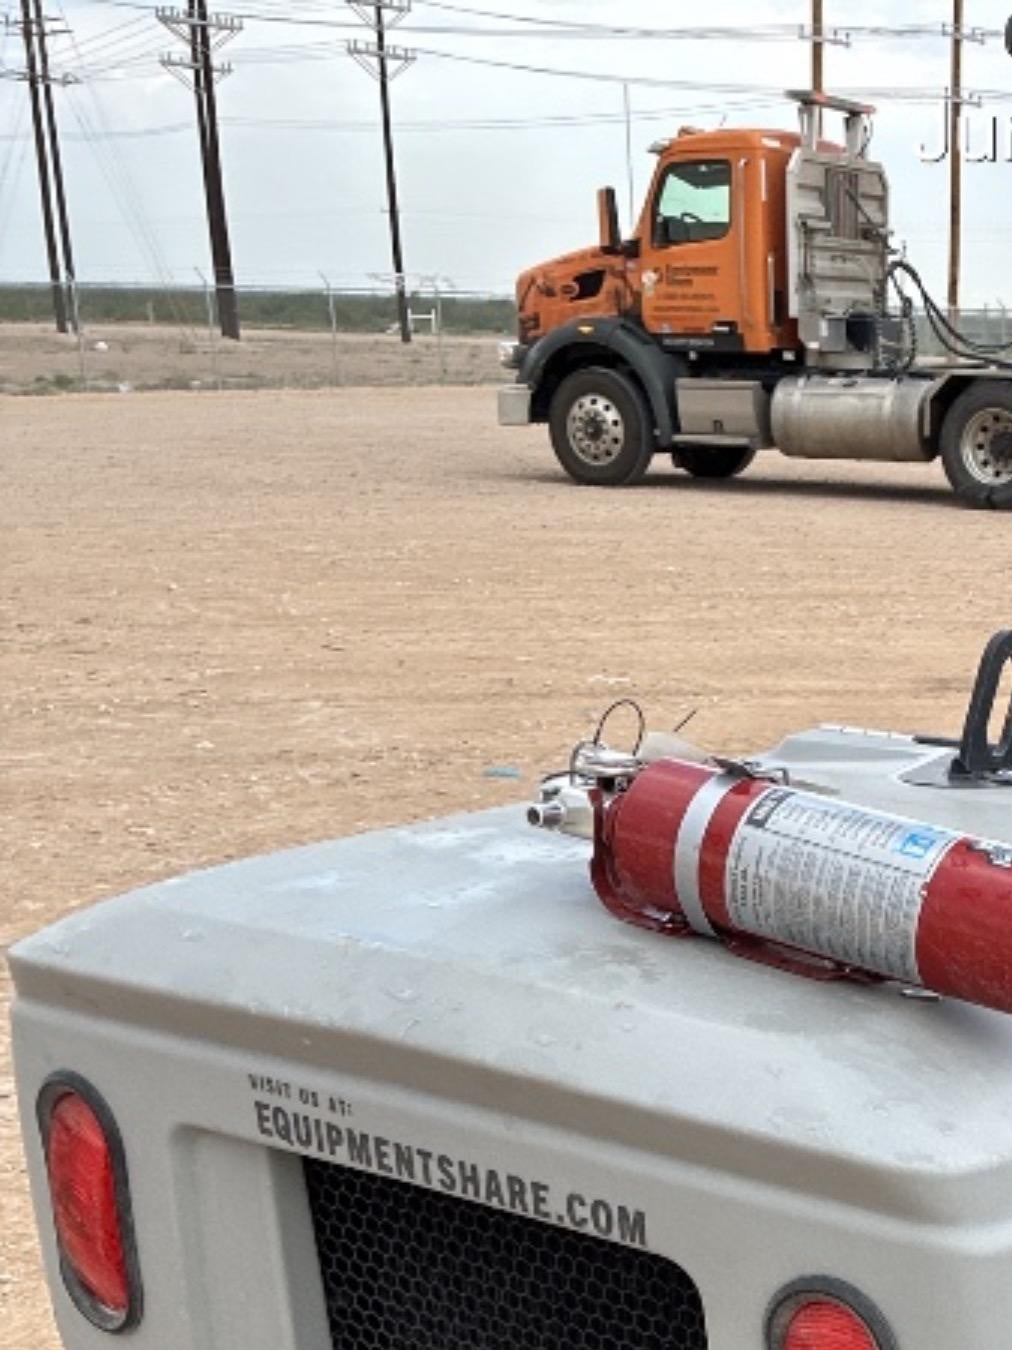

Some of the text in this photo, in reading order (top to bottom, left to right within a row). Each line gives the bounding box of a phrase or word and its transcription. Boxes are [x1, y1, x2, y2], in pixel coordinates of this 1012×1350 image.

[248, 1073, 353, 1117] VISIT US AT:
[254, 1100, 647, 1247] EQUIPMENTSHARE.COM
